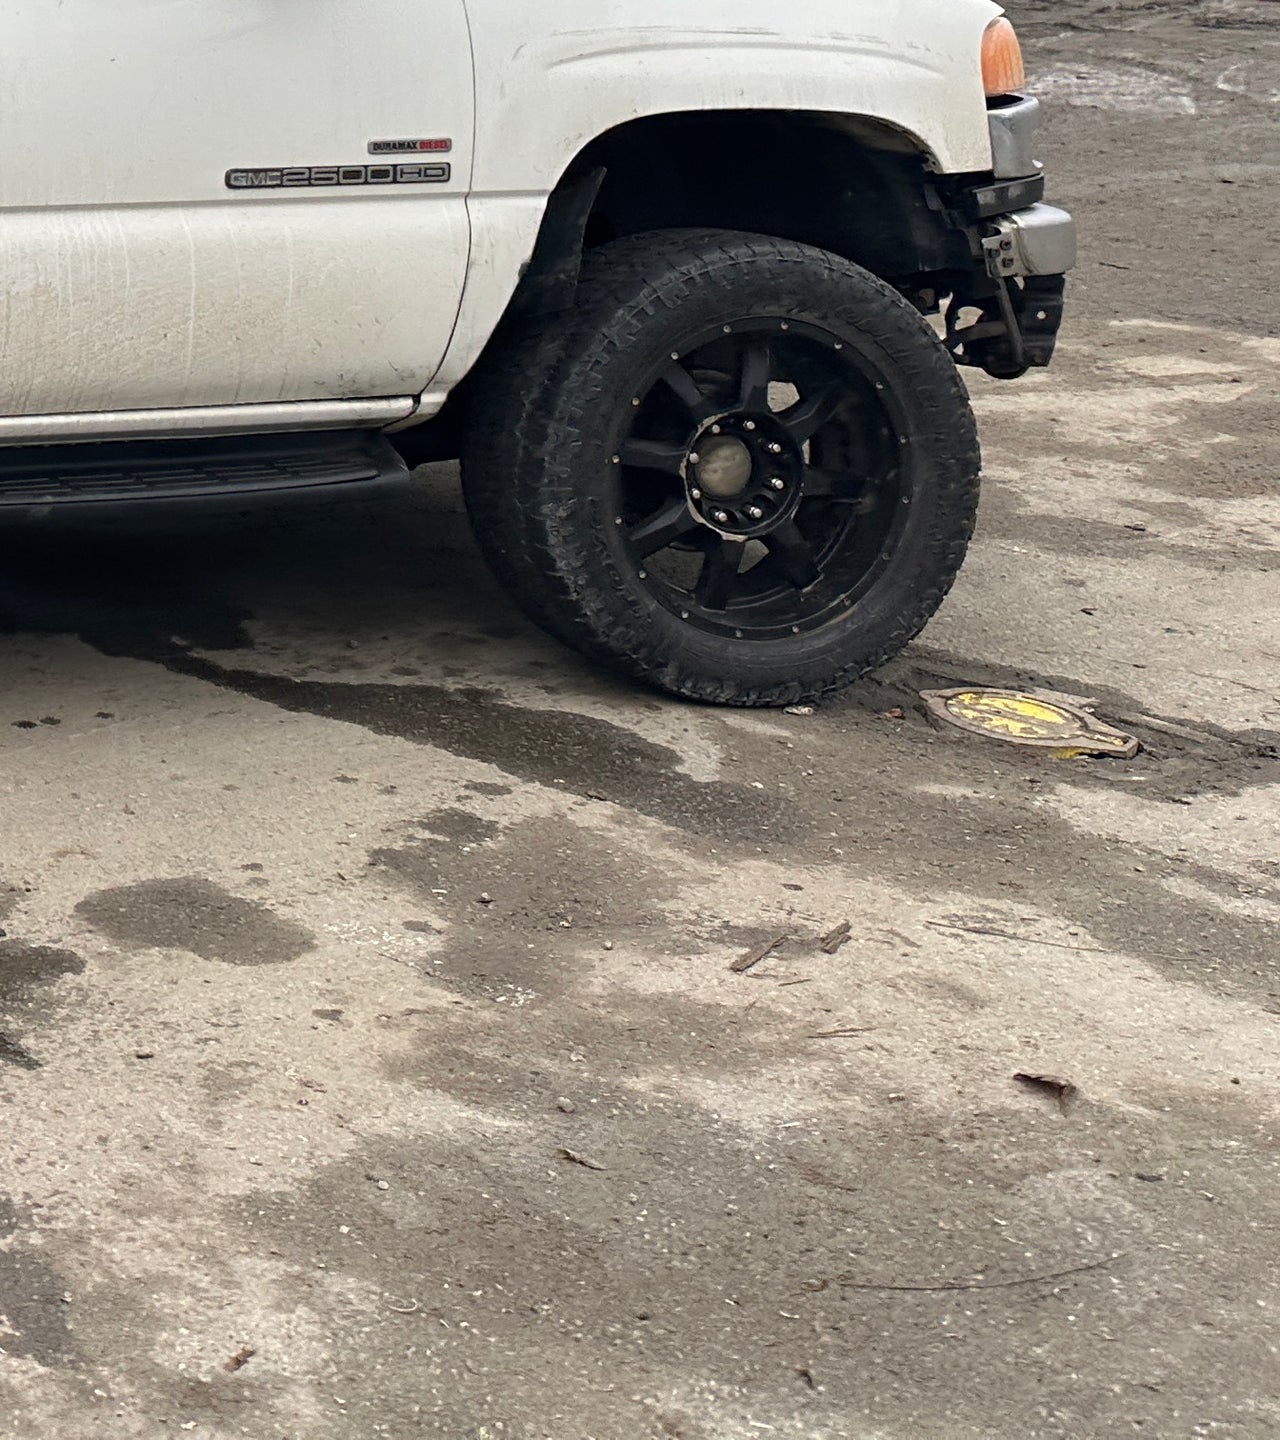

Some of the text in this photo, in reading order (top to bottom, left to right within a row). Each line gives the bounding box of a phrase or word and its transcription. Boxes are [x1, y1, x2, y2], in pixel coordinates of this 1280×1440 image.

[372, 140, 449, 152] DURAMAX DIESEL
[229, 170, 282, 187] GMC
